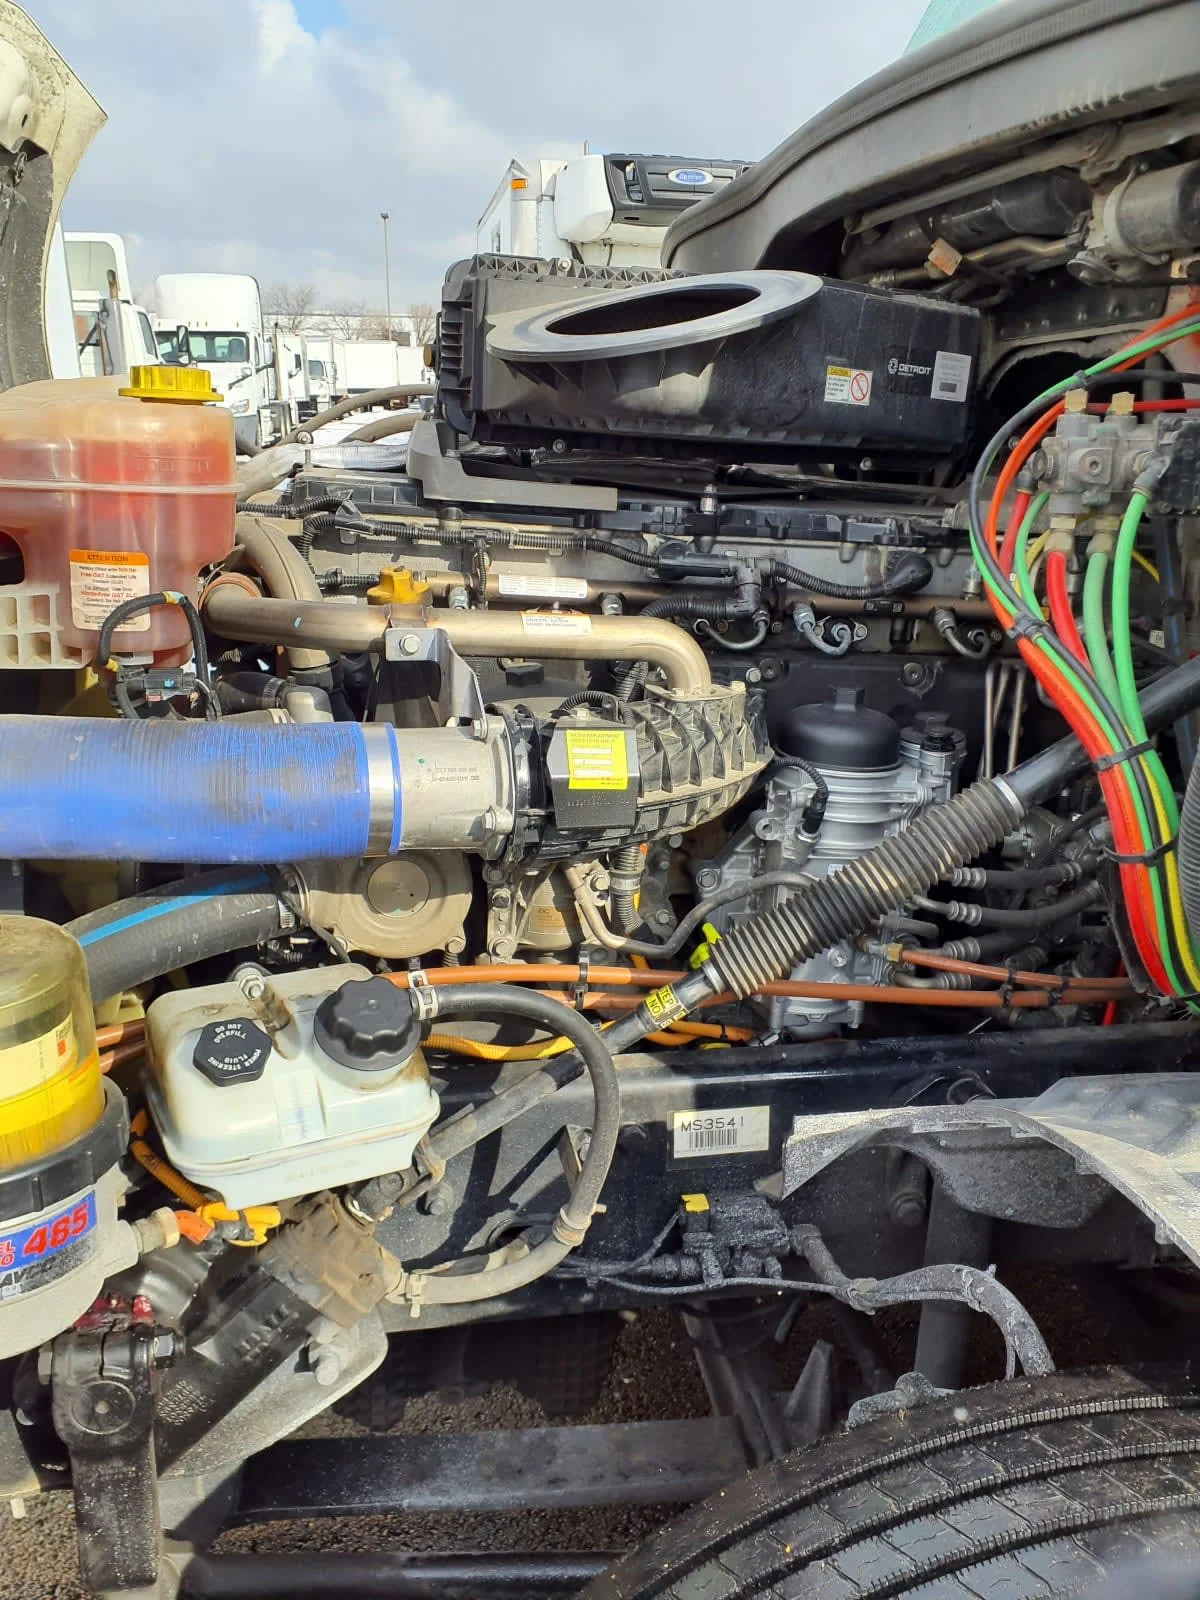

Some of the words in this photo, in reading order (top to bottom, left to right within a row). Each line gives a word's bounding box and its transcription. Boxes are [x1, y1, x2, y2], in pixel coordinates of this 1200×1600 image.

[898, 363, 932, 375] DETROIT
[214, 1030, 247, 1043] OVERFILL
[207, 1056, 242, 1071] STEERING
[223, 1053, 248, 1064] FLUID
[681, 1115, 744, 1133] MS3541
[22, 1202, 89, 1256] 485
